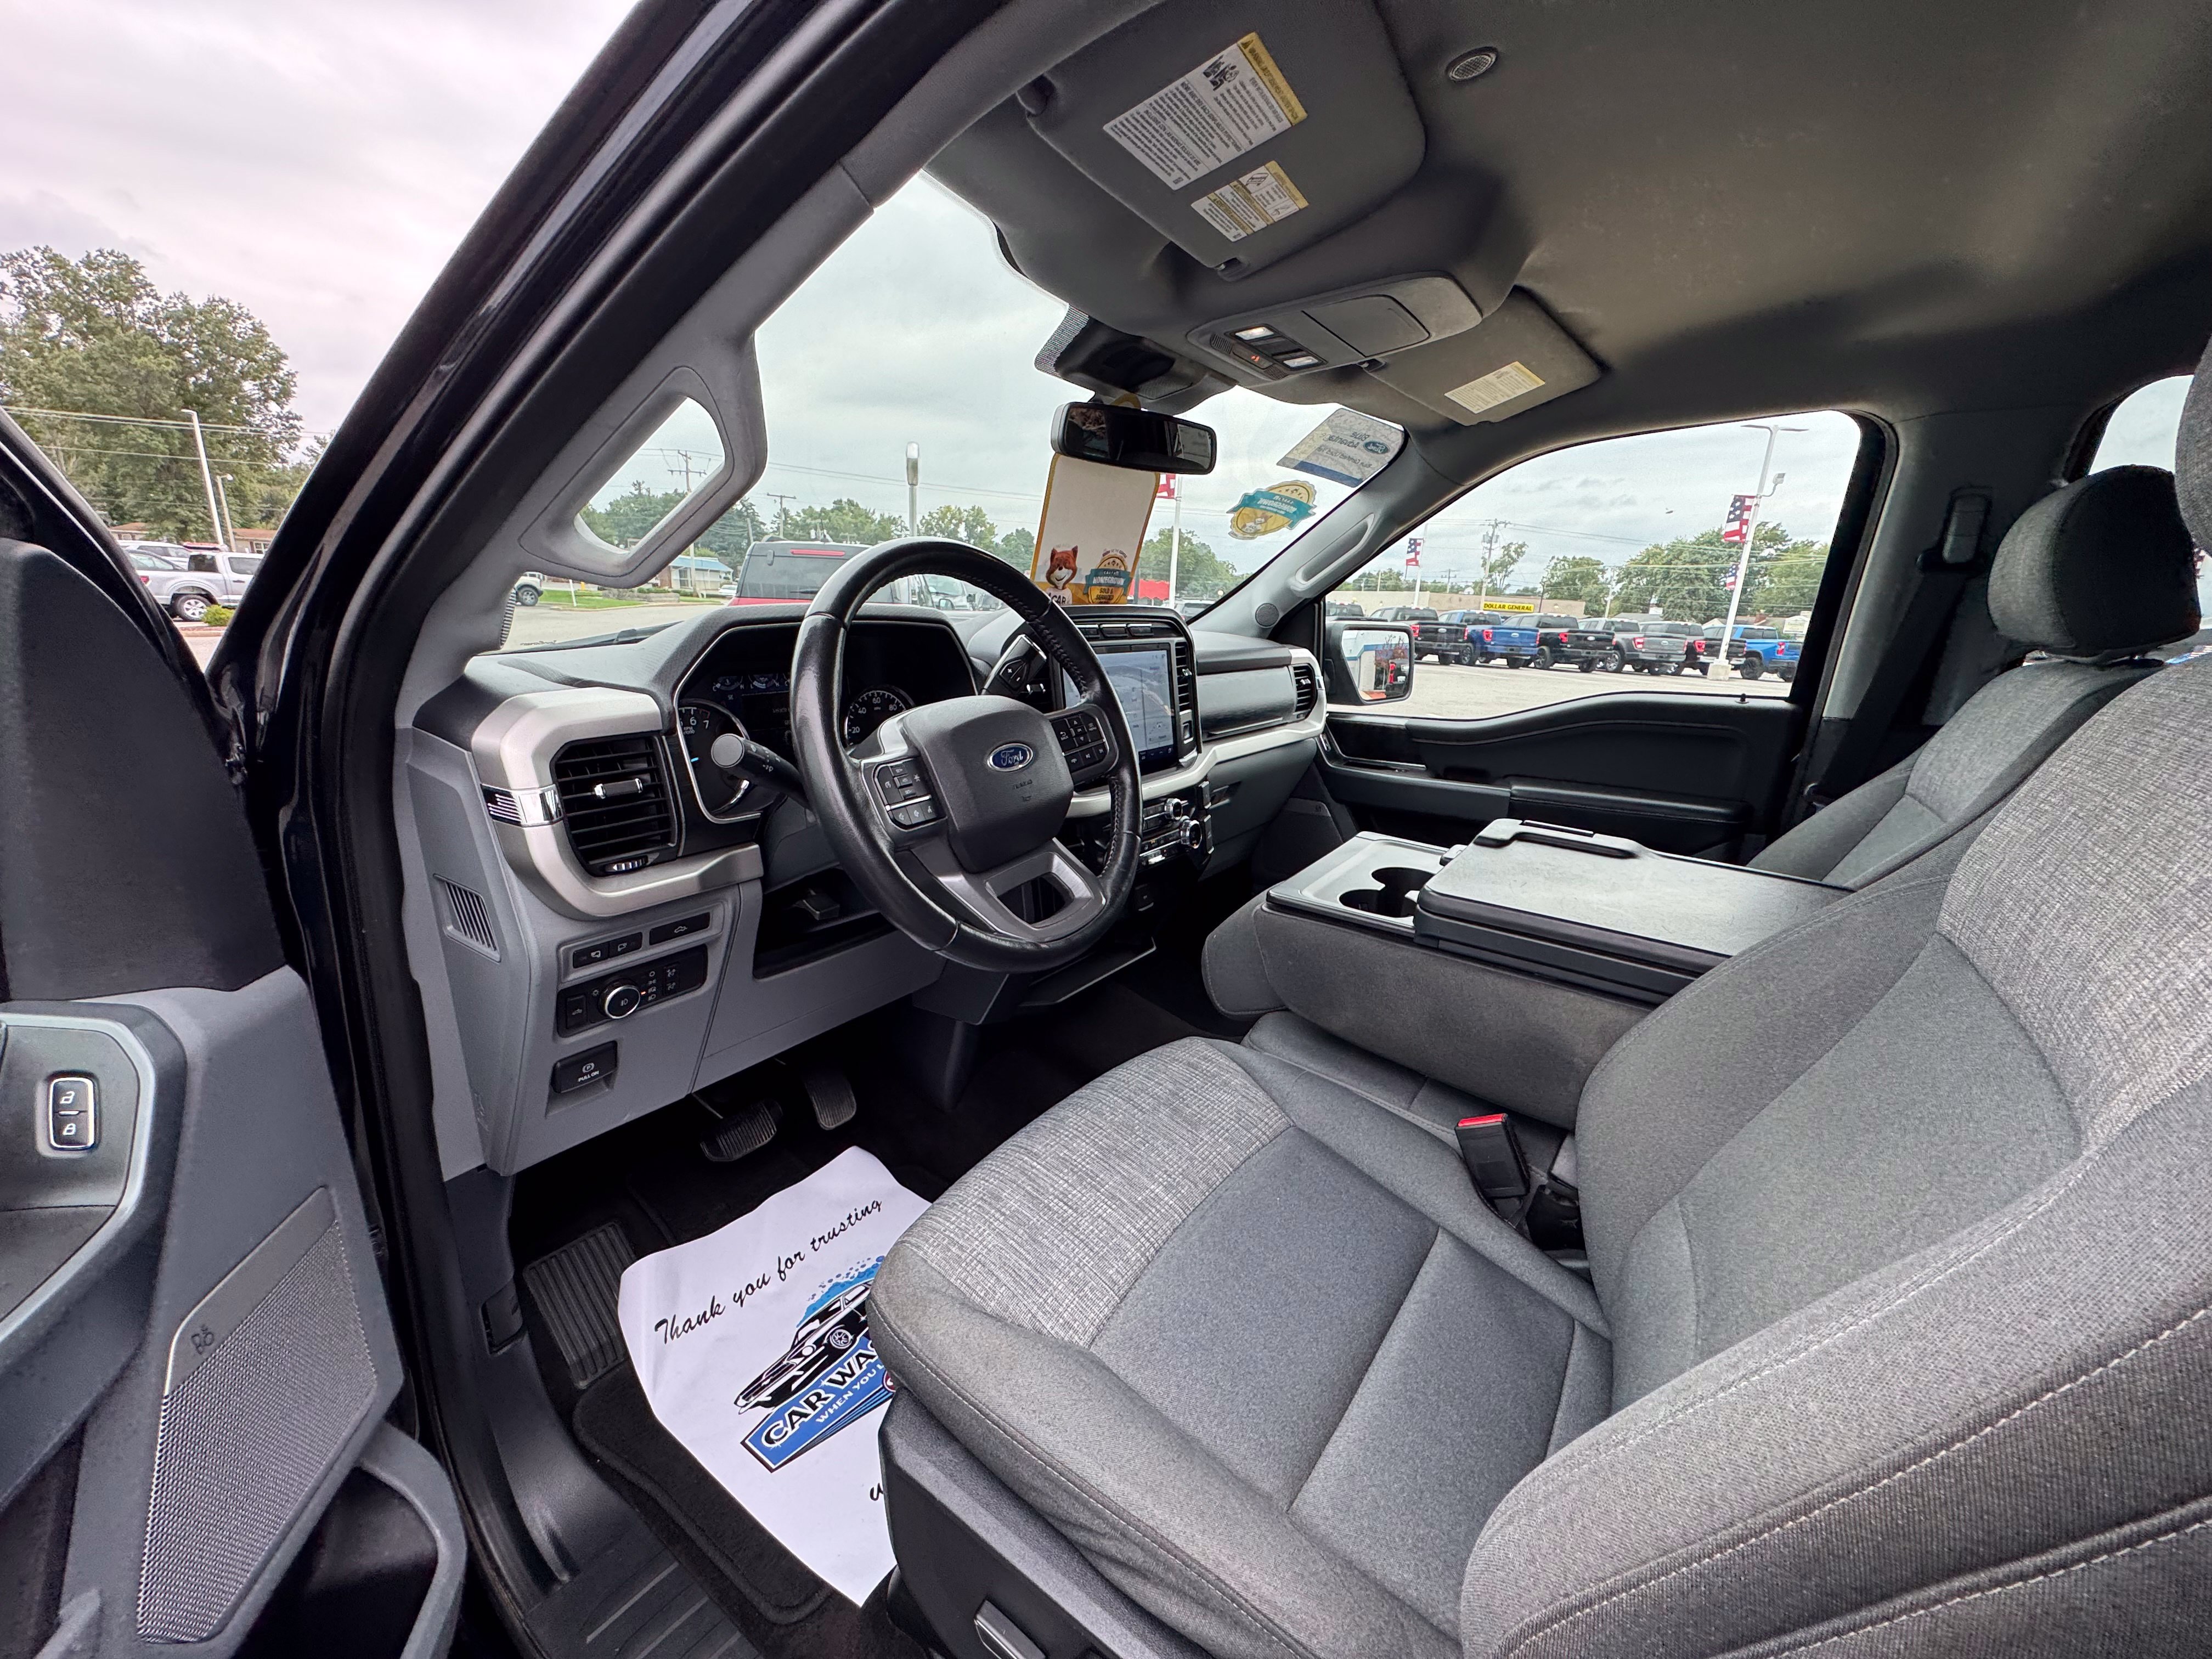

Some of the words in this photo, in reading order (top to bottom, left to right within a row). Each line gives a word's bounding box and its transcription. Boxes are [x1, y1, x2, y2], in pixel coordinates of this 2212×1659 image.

[1093, 576, 1125, 585] HOMEGROWN
[690, 716, 697, 726] 6
[703, 720, 709, 729] 7
[1000, 749, 1024, 766] Ford
[578, 1074, 591, 1082] PULL
[654, 1295, 727, 1344] Thank
[733, 1273, 771, 1308] you
[777, 1252, 805, 1282] for
[810, 1198, 882, 1252] trusting
[762, 1389, 835, 1447] CAR
[825, 1339, 878, 1389] WA
[816, 1390, 854, 1423] WHEN
[852, 1369, 877, 1391] YOU
